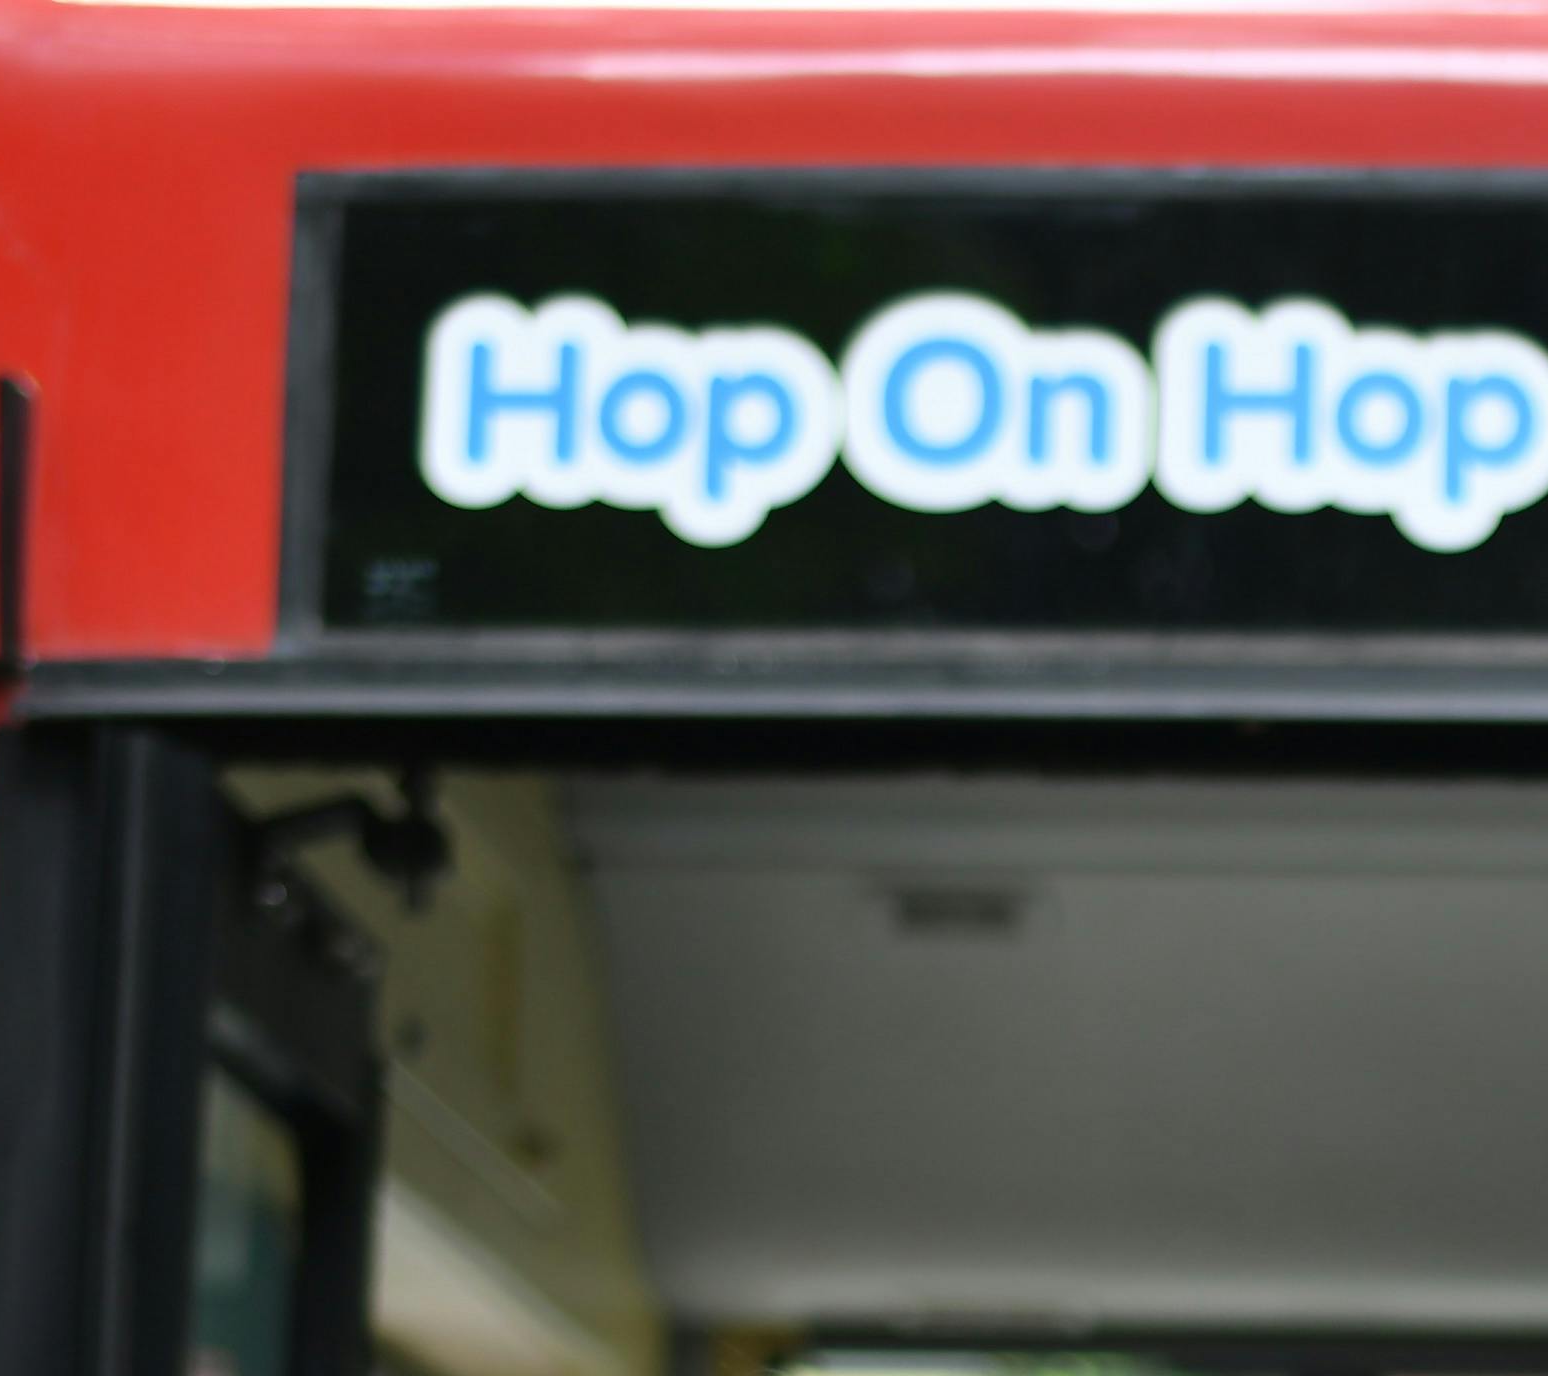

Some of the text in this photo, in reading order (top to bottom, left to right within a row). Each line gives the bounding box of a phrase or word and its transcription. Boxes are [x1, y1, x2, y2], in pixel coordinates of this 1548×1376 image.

[454, 329, 809, 512] Hop
[869, 321, 1123, 479] On
[1189, 329, 1547, 513] Hop
